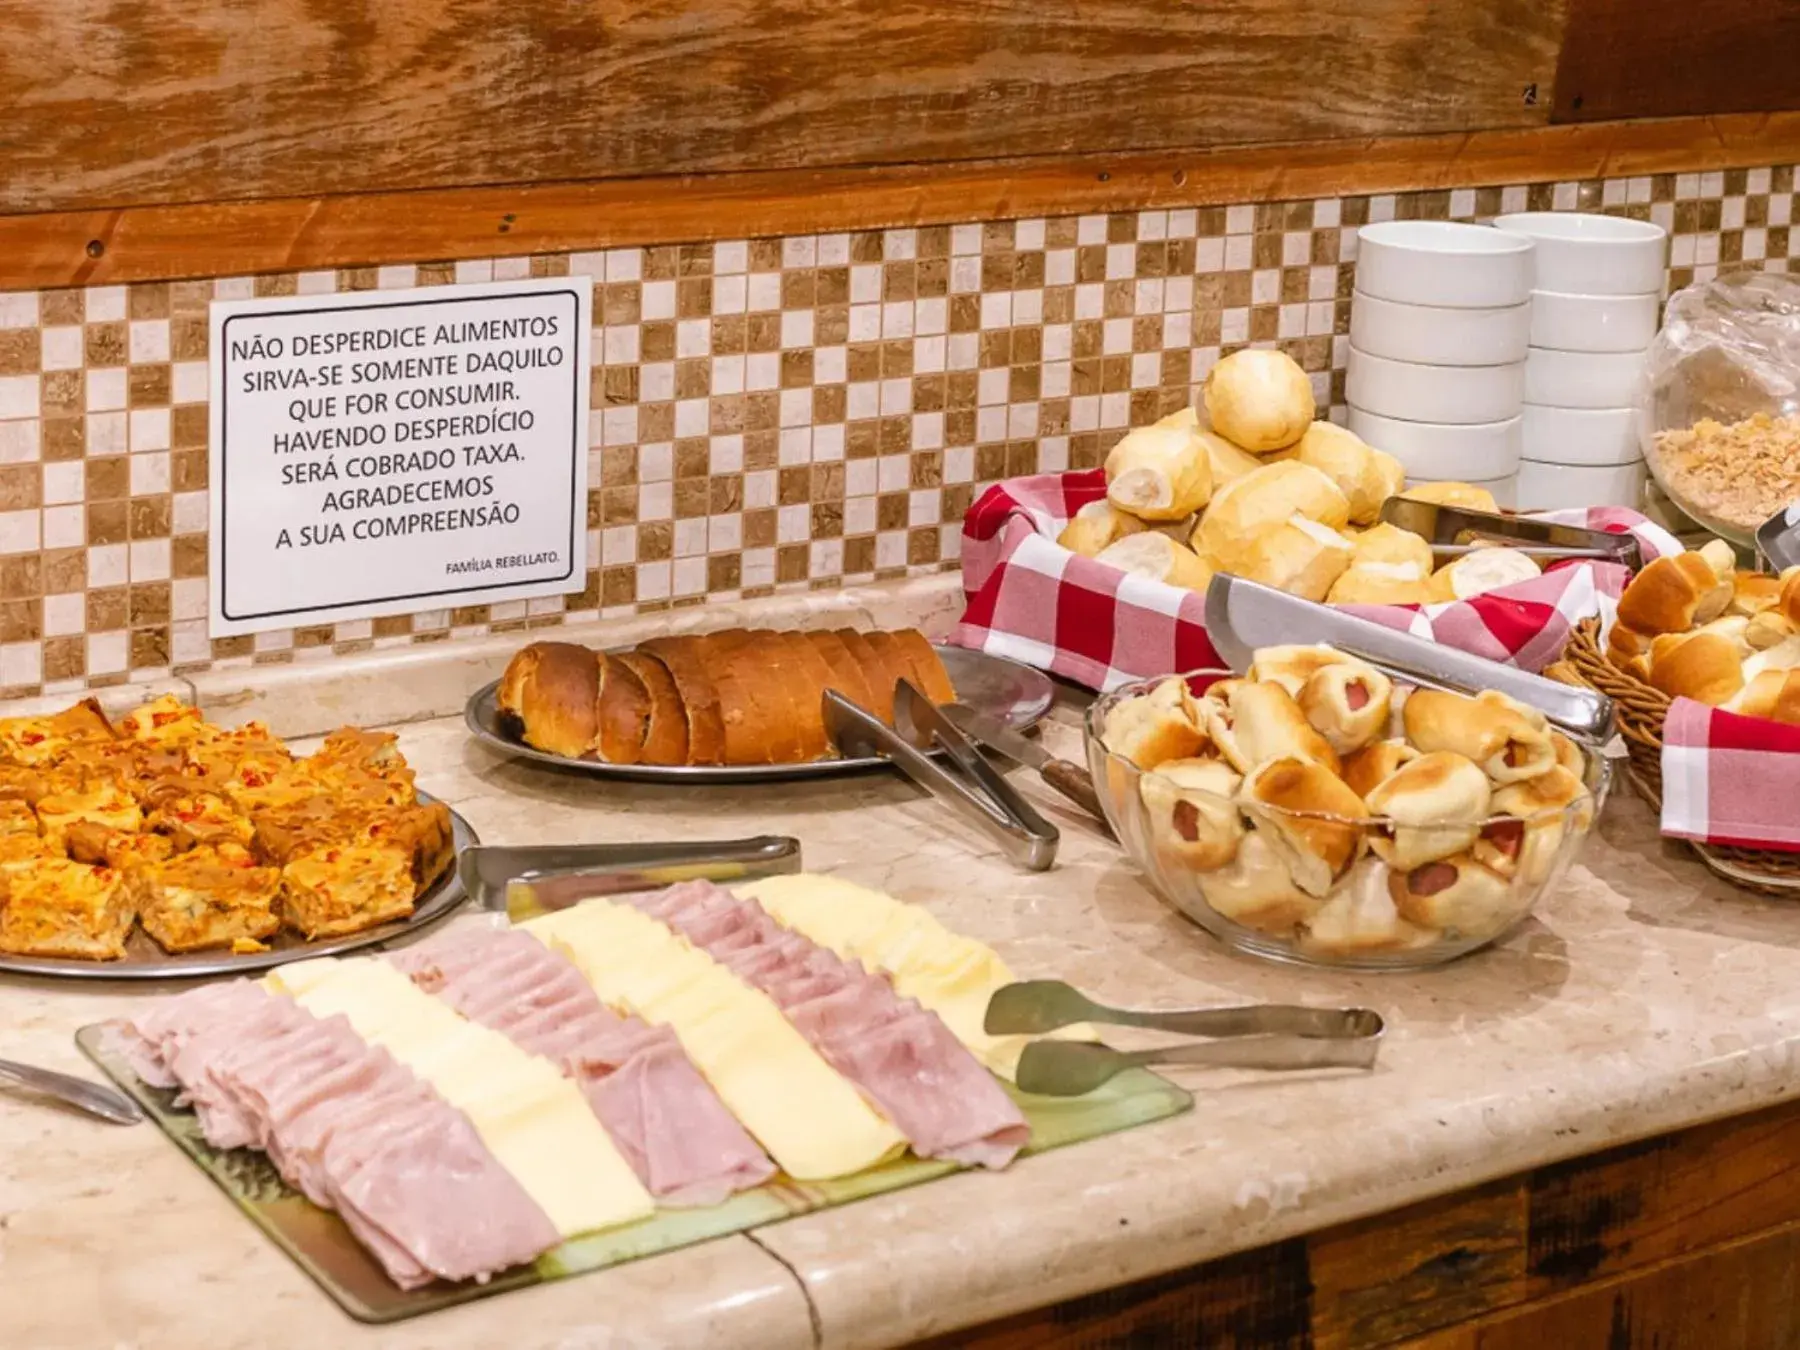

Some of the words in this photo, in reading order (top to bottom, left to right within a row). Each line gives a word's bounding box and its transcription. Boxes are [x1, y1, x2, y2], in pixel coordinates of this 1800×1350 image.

[232, 334, 284, 361] NÃO
[292, 326, 426, 357] DESPERDICE
[433, 315, 558, 345] ALIMENTOS
[243, 365, 343, 393] SIRVA-SE
[351, 355, 458, 384] SOMENTE
[466, 346, 563, 373] DAQUILO
[288, 396, 336, 423] QUE
[345, 393, 388, 417] FOR
[395, 381, 520, 410] CONSUMIR.
[274, 424, 386, 454] HAVENDO
[395, 409, 534, 442] DESPERDÍCIO
[282, 457, 339, 485] SERÁ
[345, 448, 456, 478] COBRADO
[462, 442, 525, 466] TAXA.
[322, 475, 494, 513] AGRADECEMOS
[275, 528, 293, 549] A
[300, 523, 346, 547] SUA
[353, 500, 520, 540] COMPREENSÃO
[446, 557, 493, 574] FAMÍLIA
[495, 551, 560, 569] REBELLATO.
